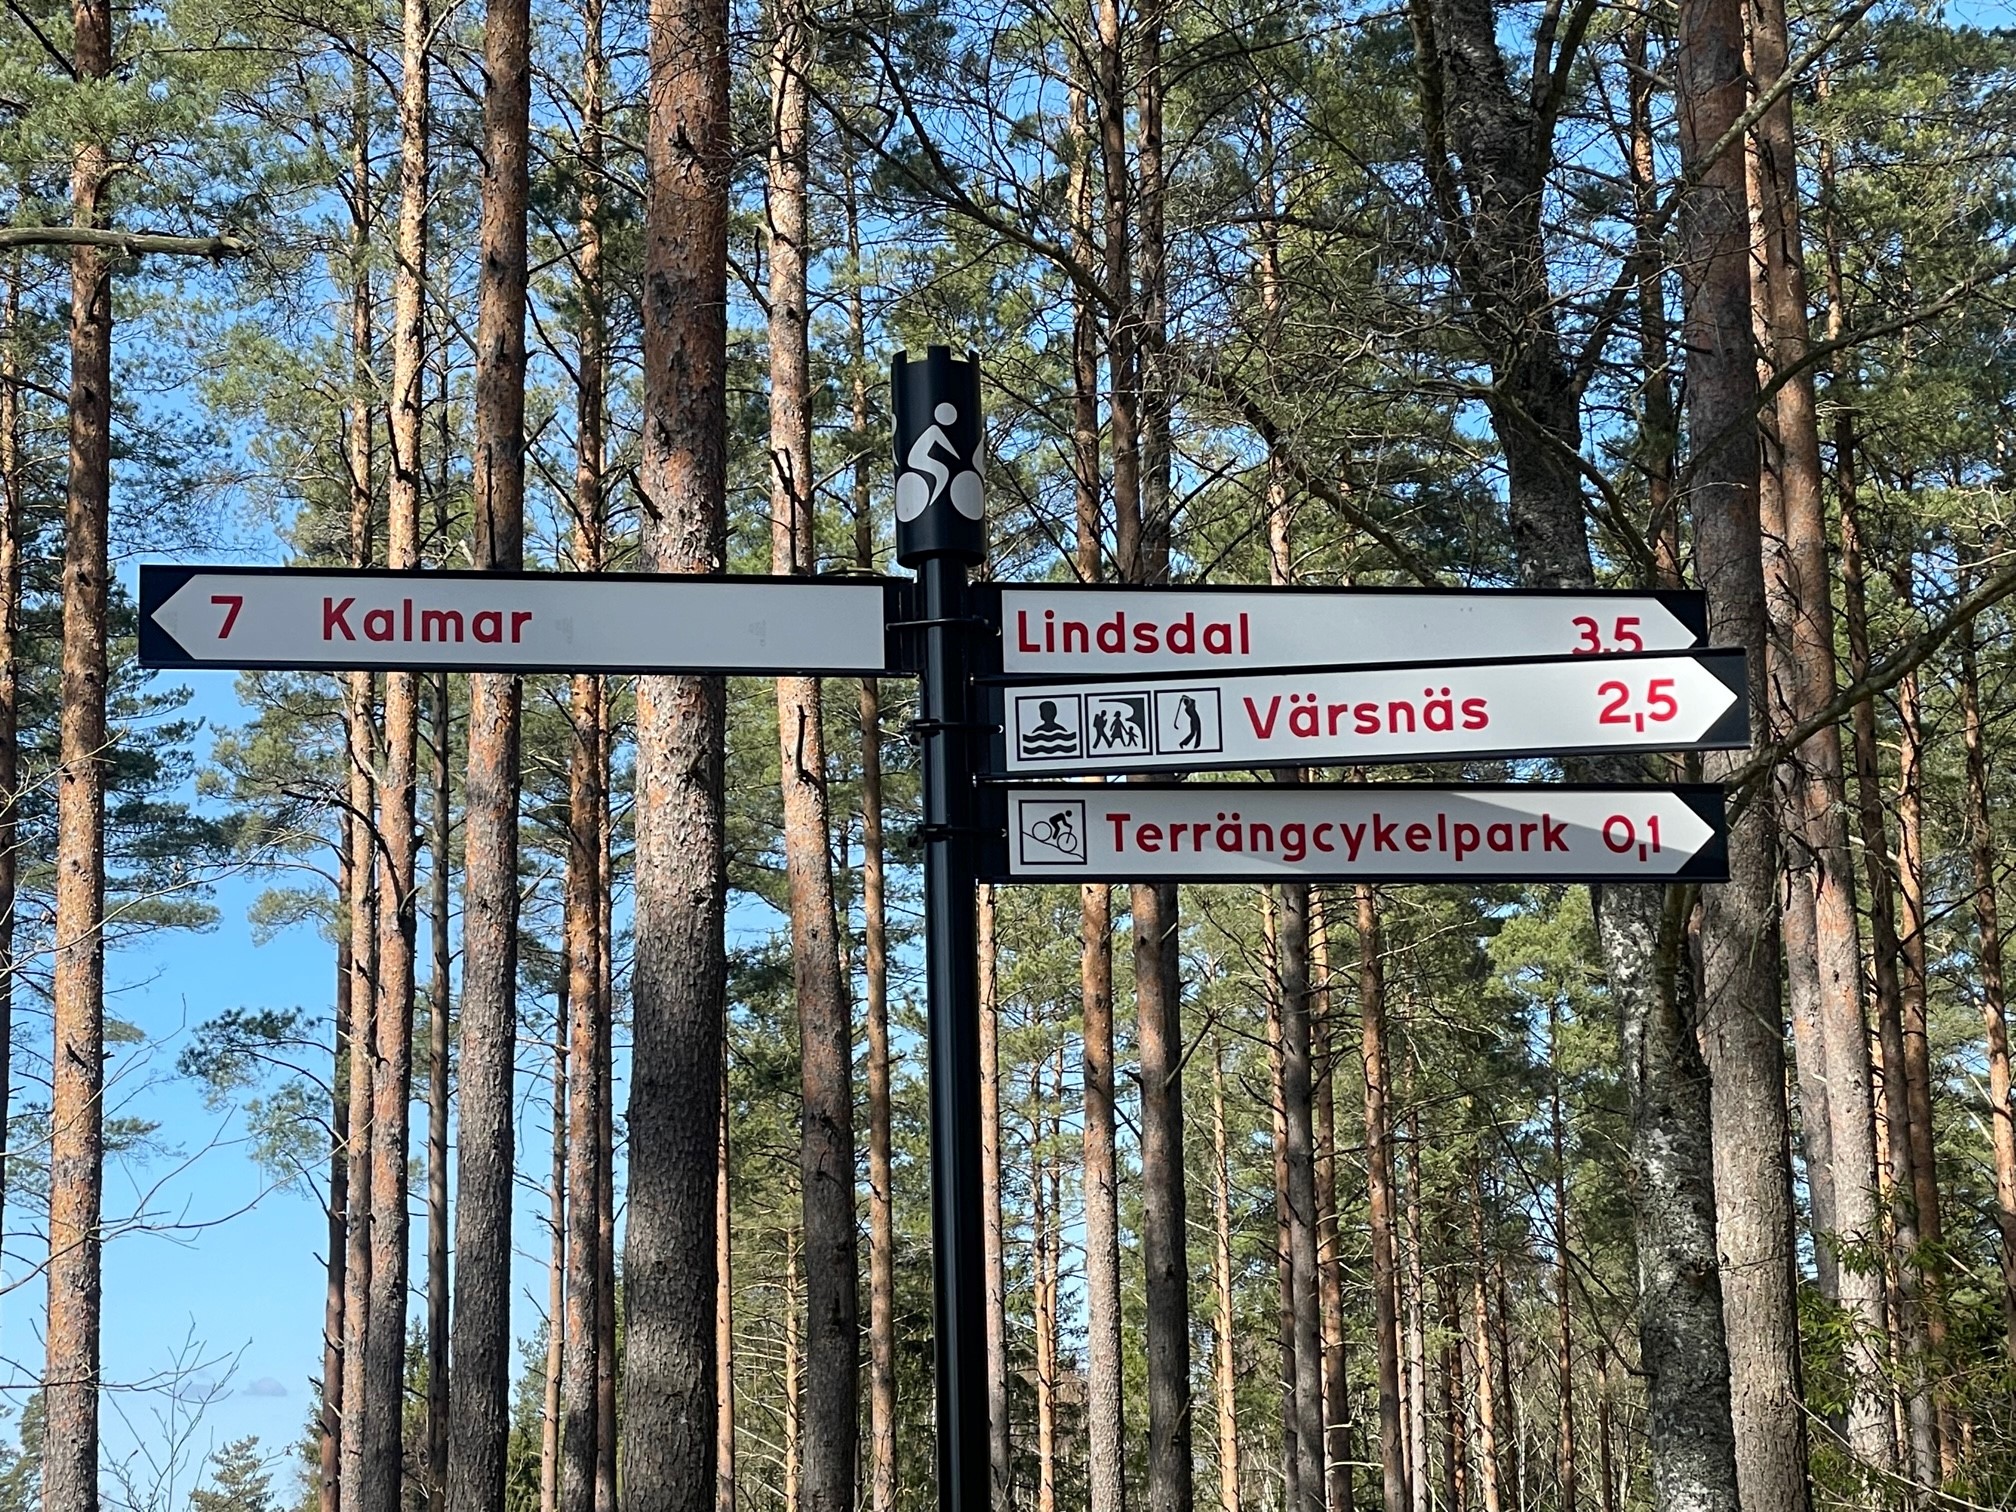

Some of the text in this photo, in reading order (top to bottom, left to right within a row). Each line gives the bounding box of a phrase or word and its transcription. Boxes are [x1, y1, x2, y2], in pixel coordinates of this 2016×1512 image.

[211, 596, 532, 643] 7 Kalmar
[1018, 609, 1250, 655] Lindsdal
[1243, 678, 1678, 739] Värsnäs 2,5
[1106, 811, 1661, 862] Terrängcykelpark 0,1
